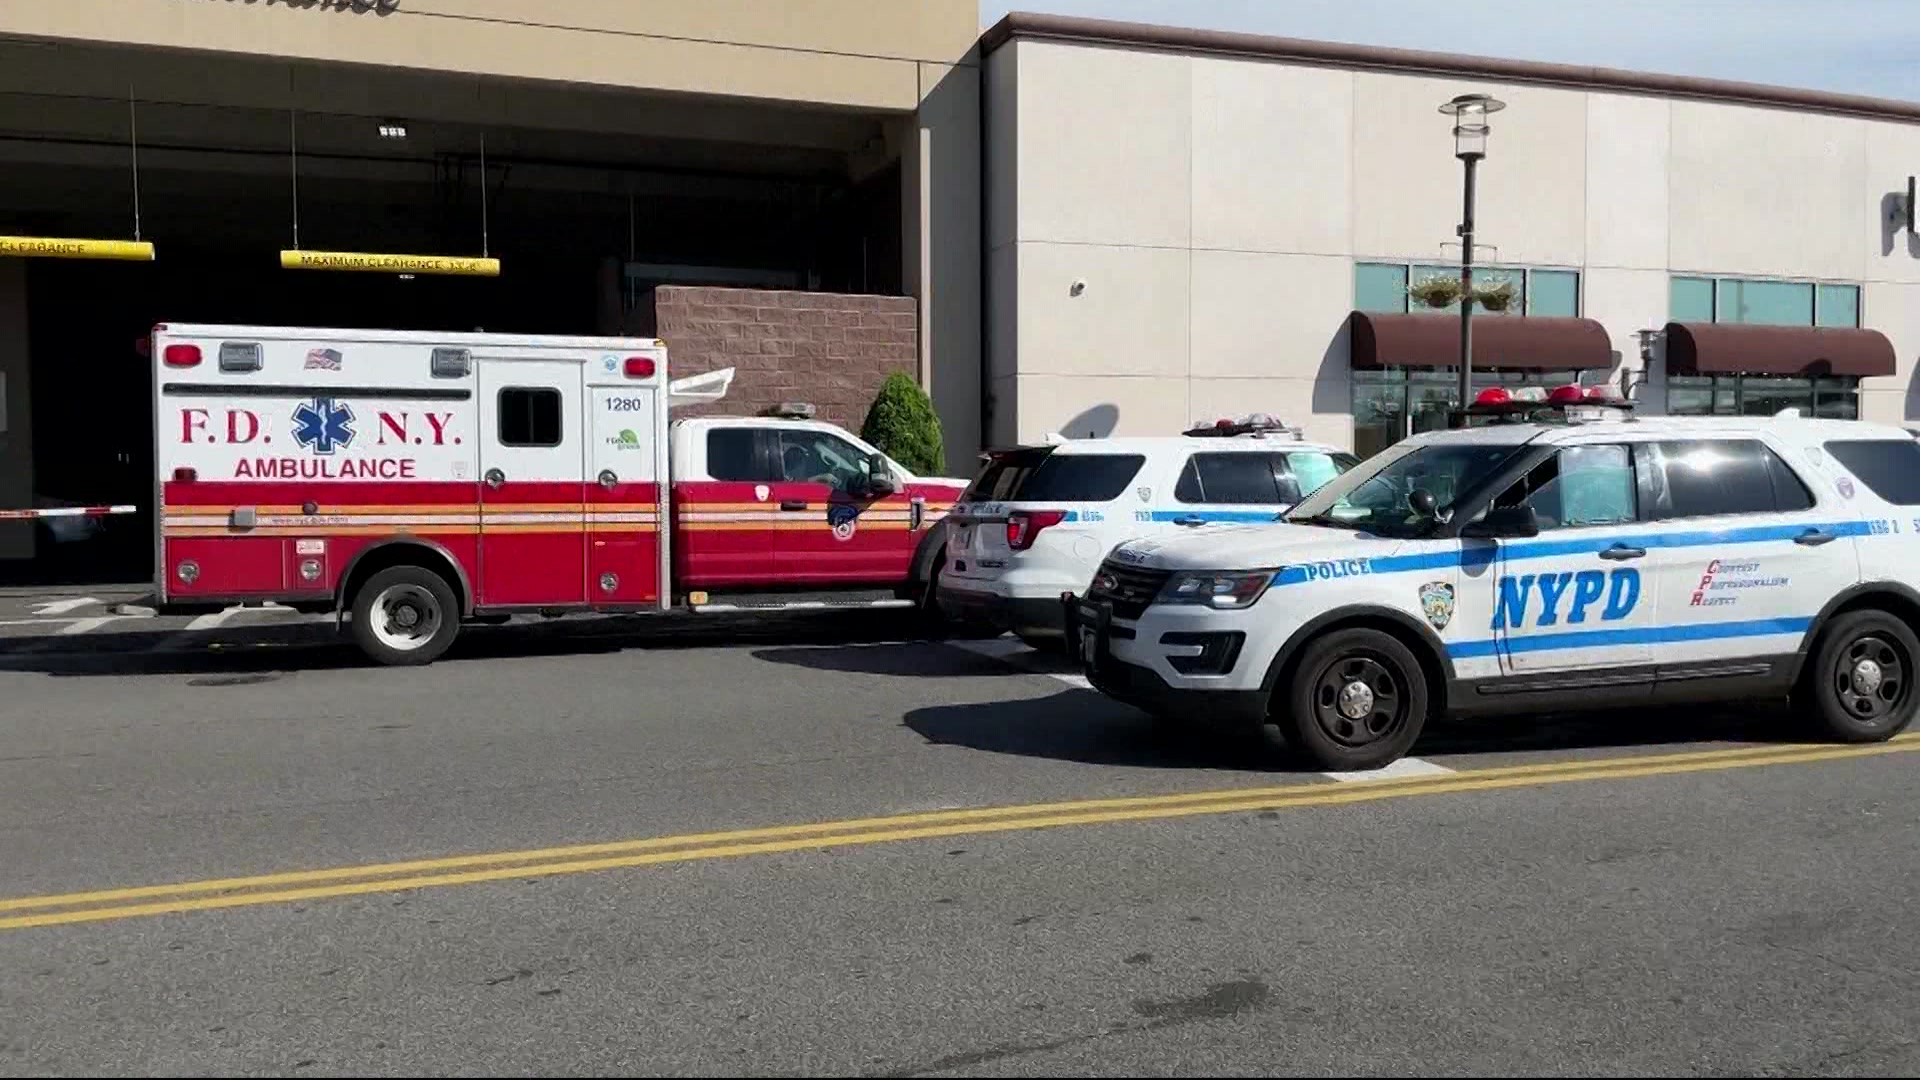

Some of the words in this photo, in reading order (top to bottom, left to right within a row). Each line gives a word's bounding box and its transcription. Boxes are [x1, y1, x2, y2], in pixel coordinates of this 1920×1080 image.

[301, 256, 365, 267] MAXIMUM
[606, 397, 641, 411] 1280
[180, 408, 272, 444] F.D.
[377, 413, 462, 446] N.Y.
[234, 458, 416, 479] AMBULANCE
[1307, 557, 1369, 580] POLICE
[1490, 567, 1641, 631] NYPD
